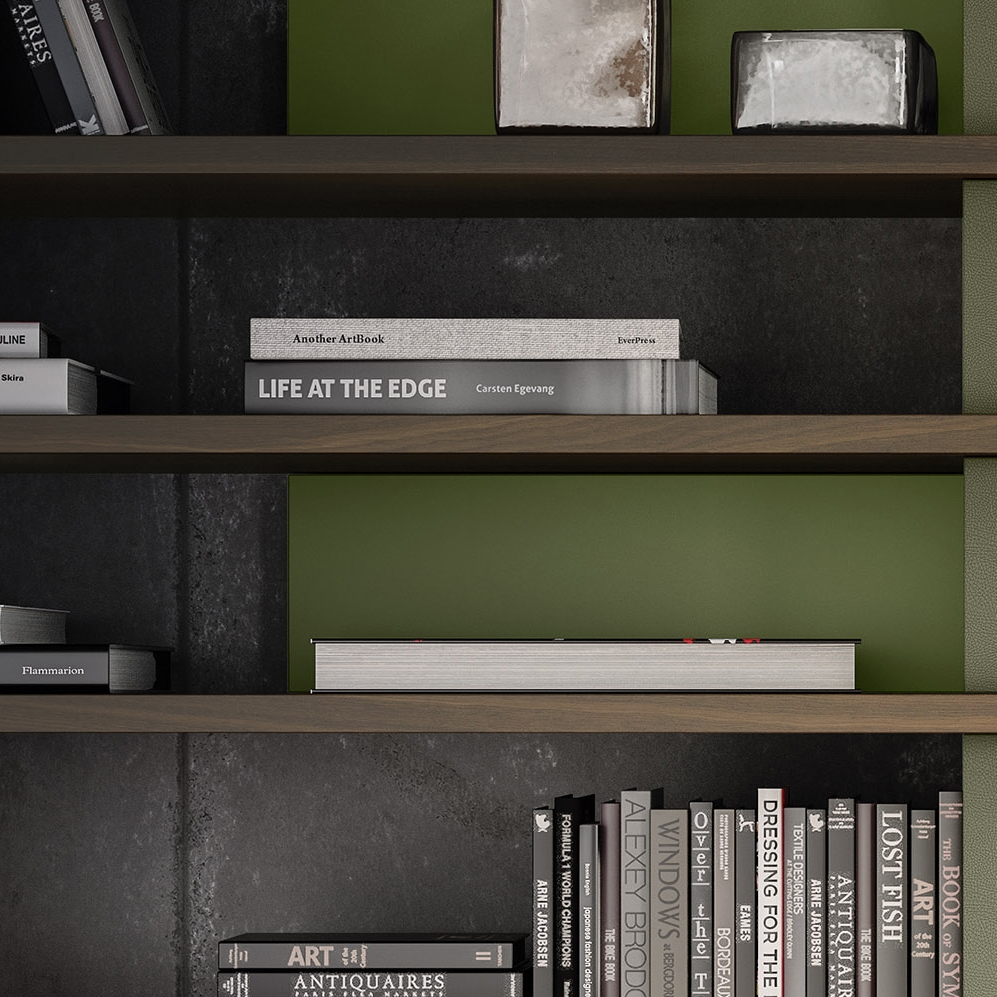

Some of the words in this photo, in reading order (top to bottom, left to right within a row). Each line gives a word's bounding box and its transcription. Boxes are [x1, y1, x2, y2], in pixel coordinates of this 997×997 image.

[293, 334, 336, 345] Another
[339, 334, 385, 345] ArtBook
[617, 336, 657, 345] EverPress
[1, 374, 24, 382] Skira
[258, 379, 302, 399] LIFE
[308, 379, 335, 399] AT
[340, 379, 382, 399] THE
[389, 379, 447, 399] EDGE
[476, 383, 512, 394] Carsten
[515, 383, 555, 396] Egevang
[22, 666, 84, 675] Flammarion
[560, 813, 572, 862] FORMULA
[624, 799, 647, 903] ALEXEY
[693, 811, 709, 882] Over
[763, 800, 778, 898] DRESSING
[881, 811, 904, 879] LOST
[942, 838, 953, 861] THE
[536, 879, 548, 908] ARNE
[560, 871, 572, 908] WORLD
[657, 818, 681, 940] WINDOWS
[942, 865, 961, 928] BOOK
[881, 884, 904, 943] FISH
[913, 878, 934, 926] ART
[536, 912, 548, 968] JACOBSEN
[560, 909, 572, 968] CHAMPIONS
[582, 906, 593, 939] japanese
[693, 904, 709, 954] the
[739, 904, 751, 941] EAMES
[763, 905, 778, 944] FOR
[942, 932, 953, 948] OF
[287, 945, 334, 967] ART
[582, 941, 593, 967] fashion
[763, 949, 778, 988] THE
[911, 951, 935, 960] Century
[294, 974, 445, 992] ANTIQUAIRES
